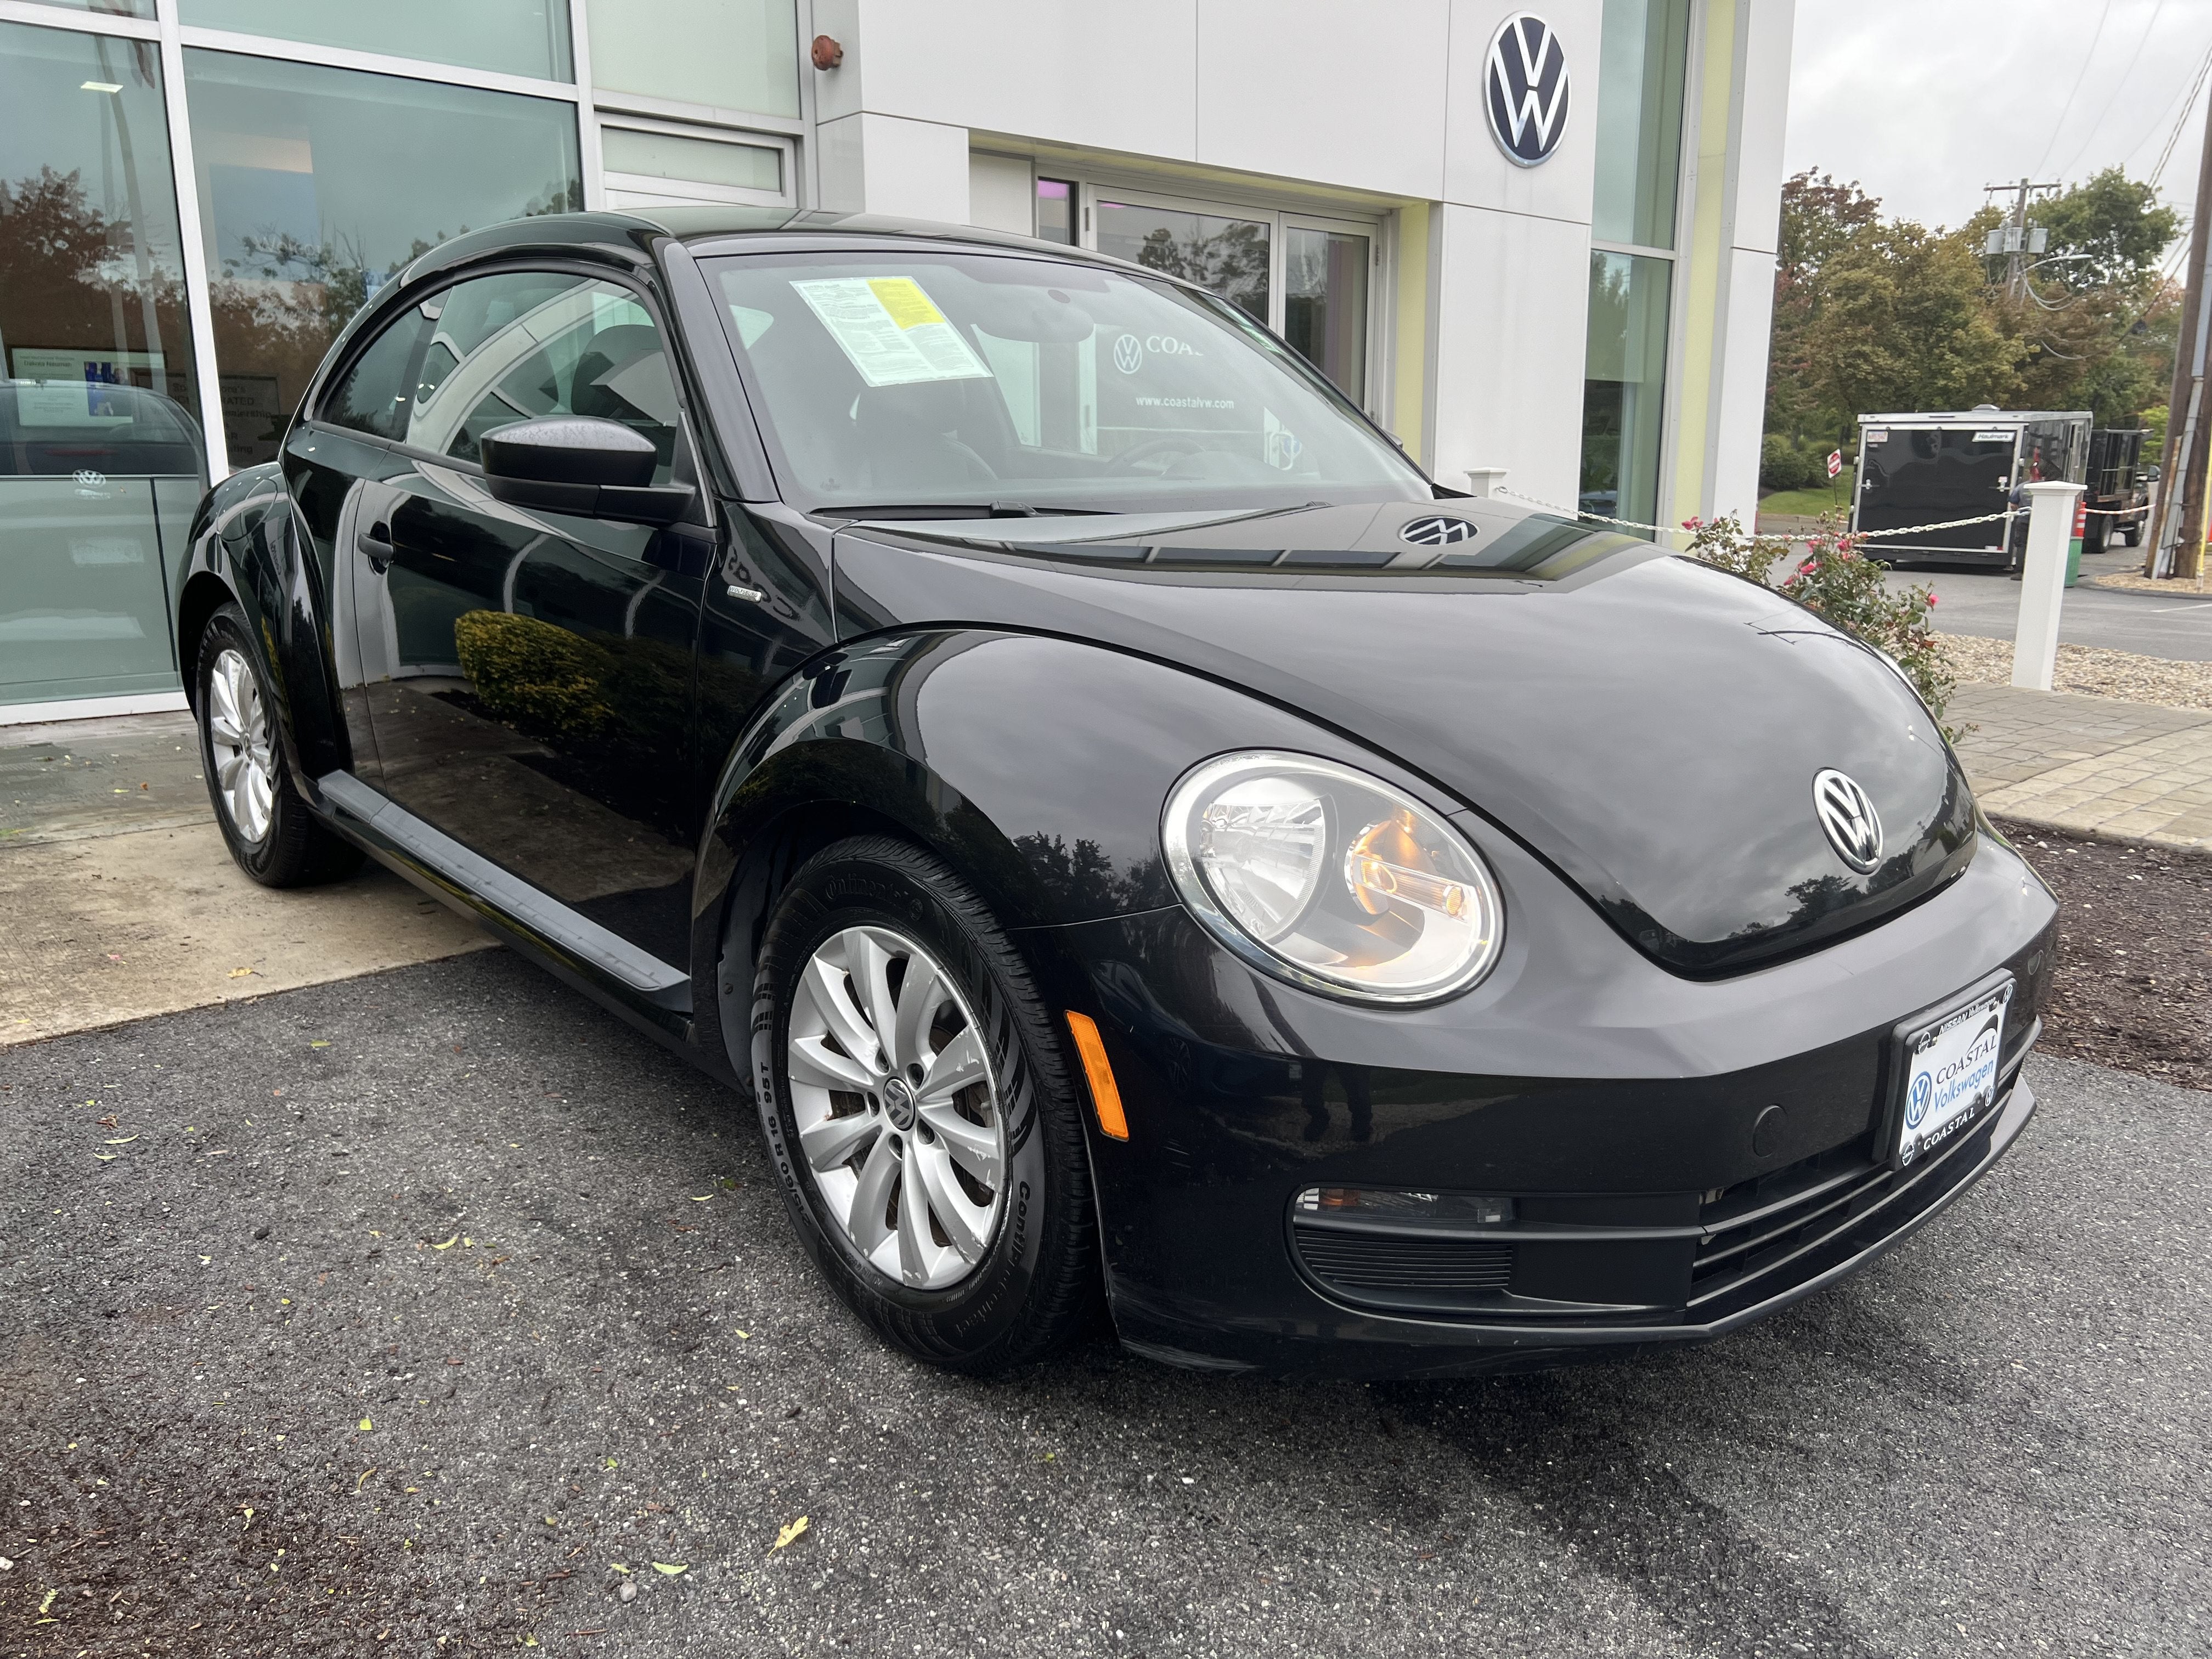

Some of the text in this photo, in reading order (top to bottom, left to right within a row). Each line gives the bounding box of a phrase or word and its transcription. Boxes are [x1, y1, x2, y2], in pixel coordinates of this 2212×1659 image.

[1487, 14, 1569, 161] VW
[1114, 334, 1142, 374] VW
[1136, 396, 1234, 409] www.coastalvw.com
[1814, 769, 1883, 868] VW
[1939, 1012, 1968, 1035] NISSAN
[1937, 1034, 1997, 1085] COASTAL
[1906, 1073, 1931, 1128] VW
[1934, 1059, 1994, 1112] Volkswagen
[774, 1142, 784, 1156] R
[1923, 1107, 1975, 1151] COASTAL
